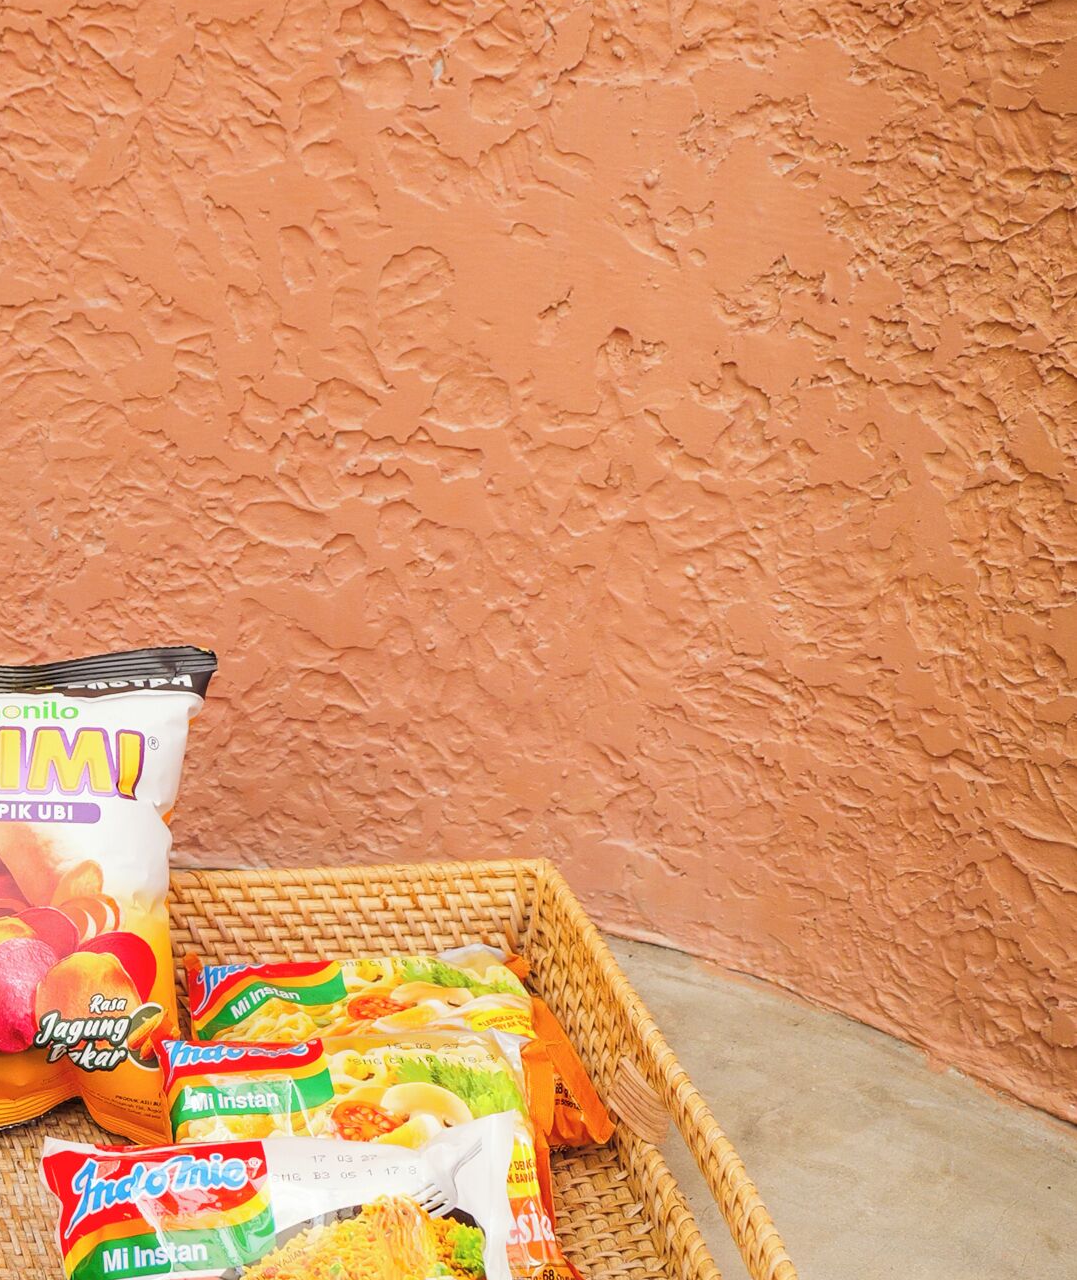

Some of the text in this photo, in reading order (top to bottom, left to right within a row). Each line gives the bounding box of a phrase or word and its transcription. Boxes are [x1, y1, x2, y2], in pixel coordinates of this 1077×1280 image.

[37, 803, 73, 820] UBI
[89, 994, 127, 1014] Rasa
[230, 986, 301, 1019] Mi Instan
[35, 1012, 130, 1044] Jagung
[190, 1091, 280, 1111] Mi Instan
[101, 1242, 208, 1274] Mi Instan
